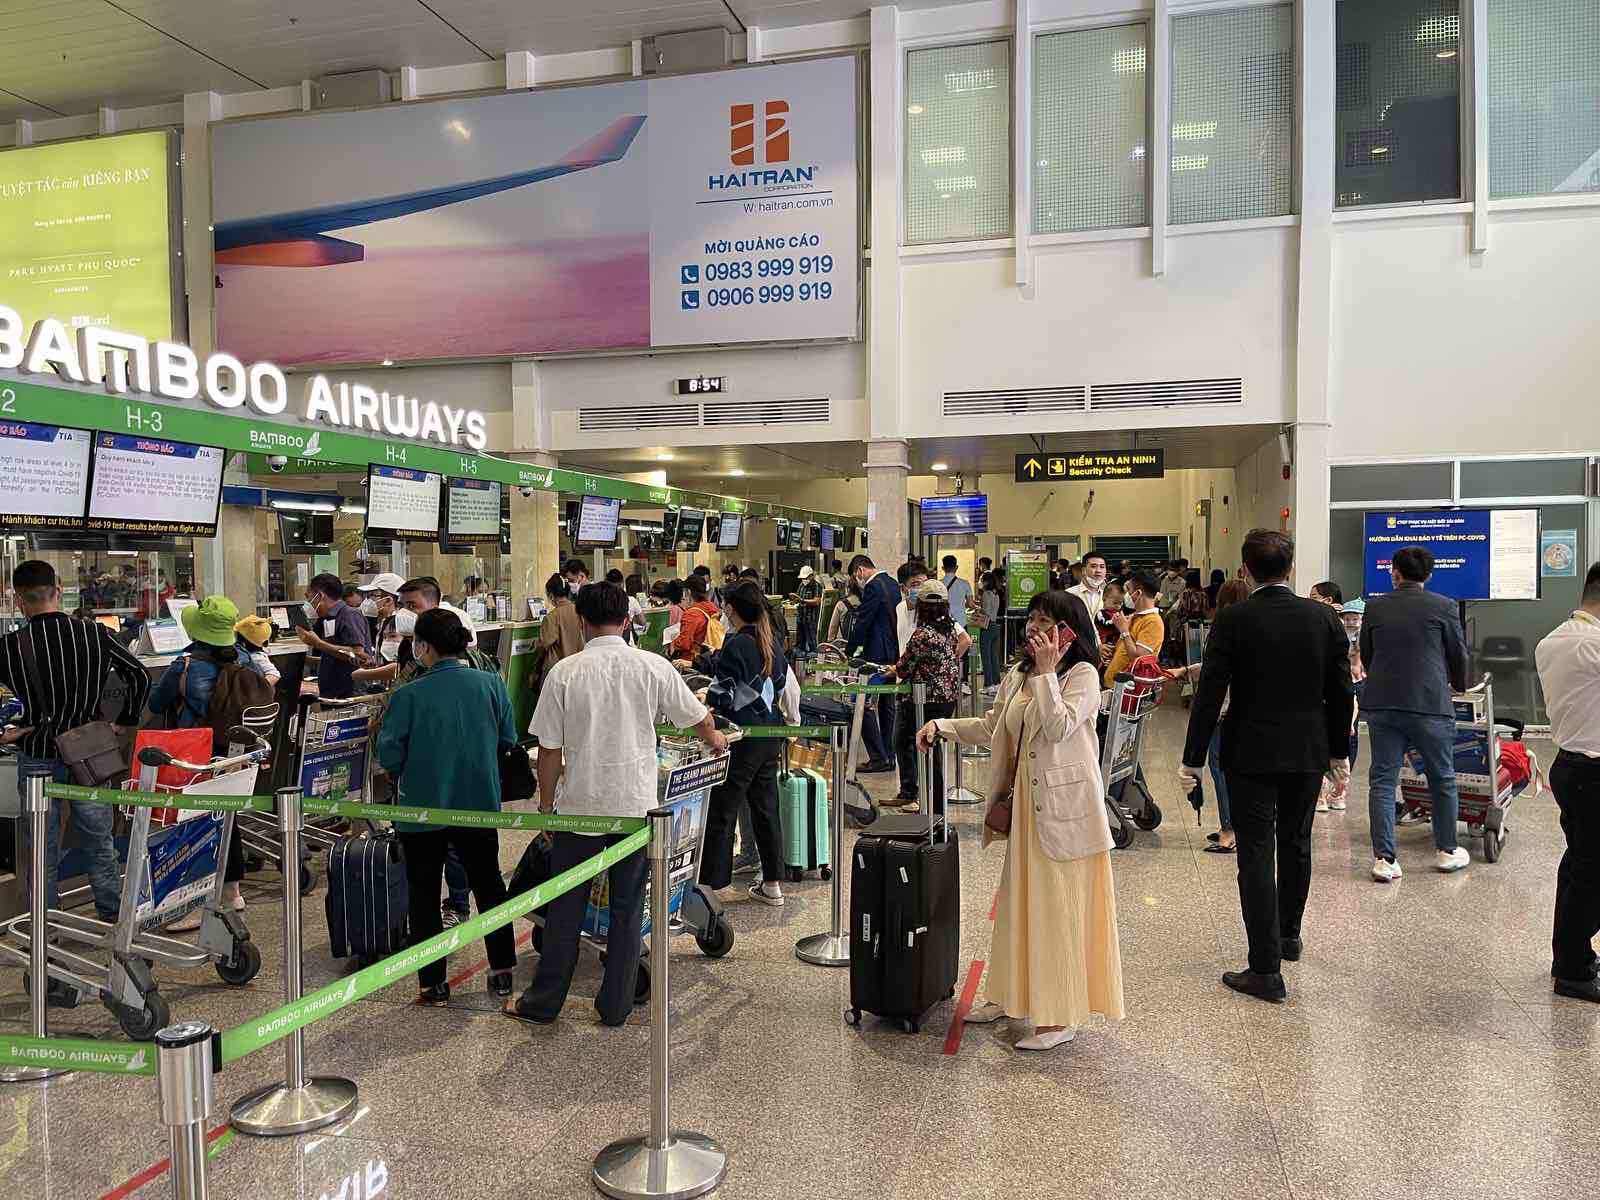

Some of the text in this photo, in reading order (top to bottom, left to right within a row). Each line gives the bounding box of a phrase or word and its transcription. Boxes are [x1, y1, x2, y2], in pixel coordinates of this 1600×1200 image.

[83, 167, 121, 188] RIÊNG
[758, 197, 833, 213] haitran.com.vn
[704, 233, 820, 254] MỜI QUẢNG CÁO
[705, 254, 833, 281] 0983 999 919
[707, 280, 832, 308] 0906 999 919
[0, 303, 487, 450] BAMBOO AIRWAYS
[126, 405, 163, 432] H-3
[249, 430, 304, 448] BAMBOO
[385, 446, 408, 464] H-4
[1069, 455, 1157, 467] KIỂM TRA AN NINH
[461, 457, 478, 474] H-5
[1069, 466, 1132, 477] Security Check
[585, 477, 598, 491] H-6
[23, 515, 46, 525] khách
[112, 522, 125, 531] test
[125, 523, 147, 531] results
[148, 524, 168, 532] before
[169, 525, 178, 533] the
[384, 940, 449, 977] BAMBOO AIRWAYS
[256, 990, 344, 1037] BAMBOO AIRWAYS
[11, 1046, 128, 1064] BAMBOO AIRWAYS
